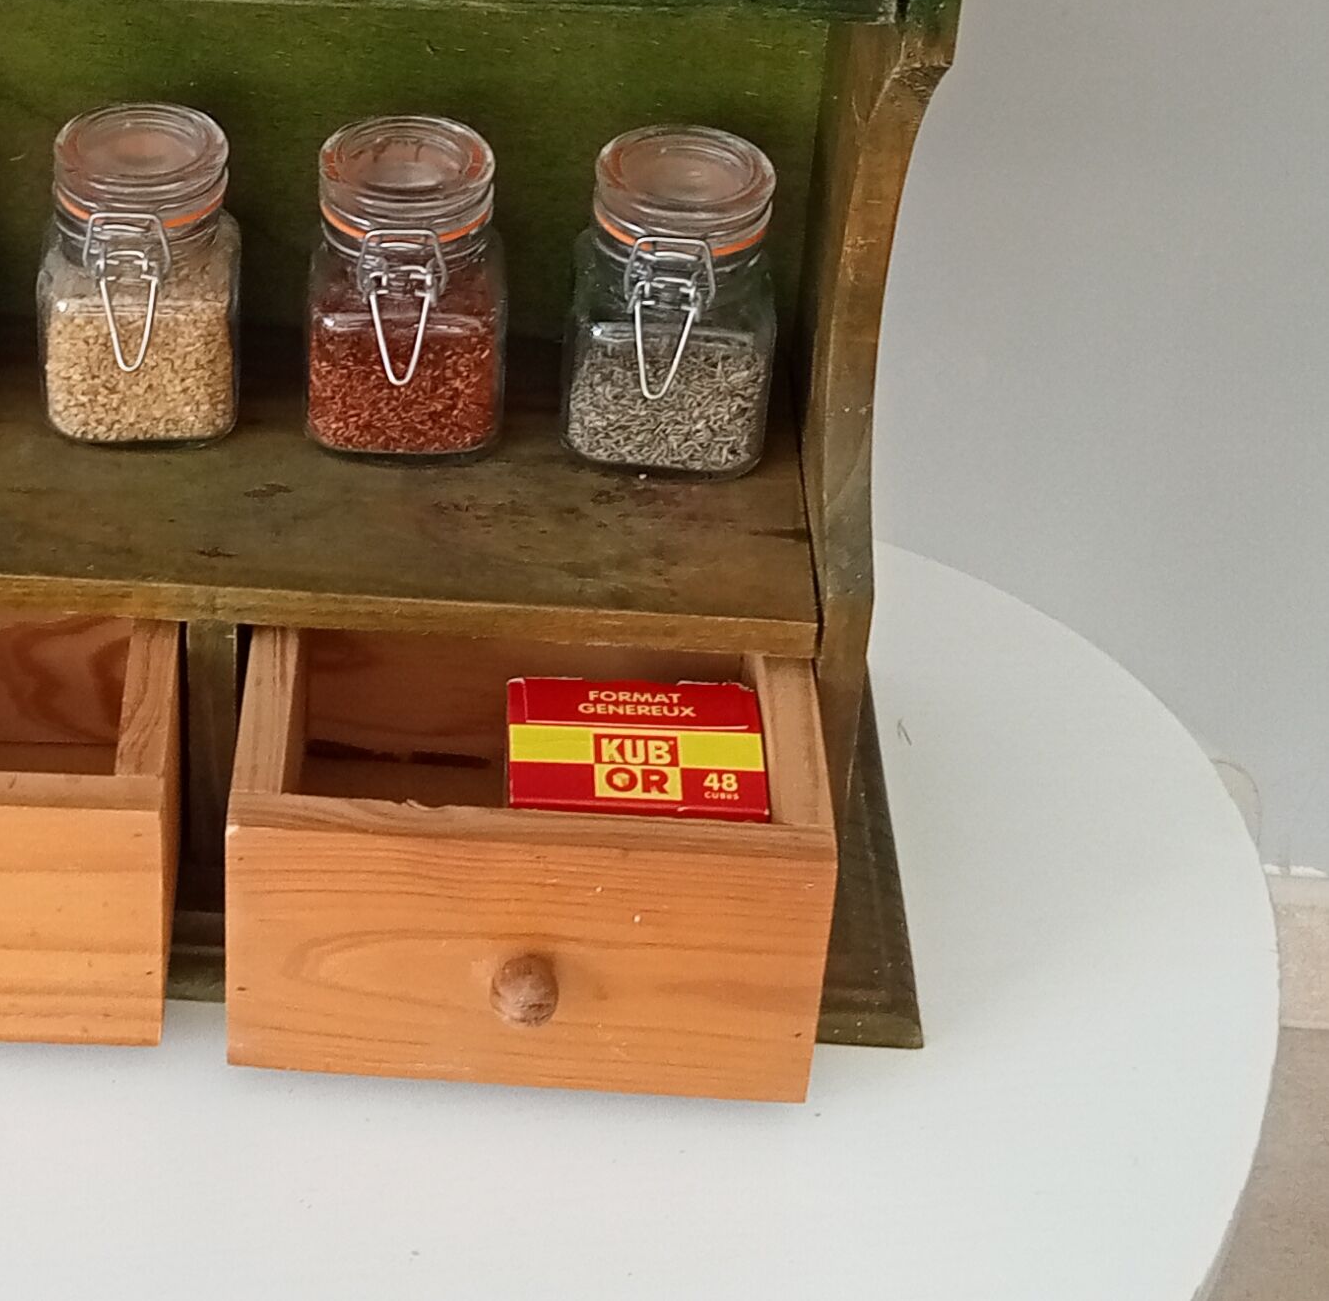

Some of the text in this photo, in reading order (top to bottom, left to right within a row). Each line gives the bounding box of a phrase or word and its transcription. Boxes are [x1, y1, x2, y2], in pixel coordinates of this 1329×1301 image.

[588, 690, 682, 704] FORMAT
[577, 703, 697, 717] GENEREUX
[601, 737, 672, 765] KUB
[605, 767, 669, 794] OR
[703, 773, 738, 791] 48
